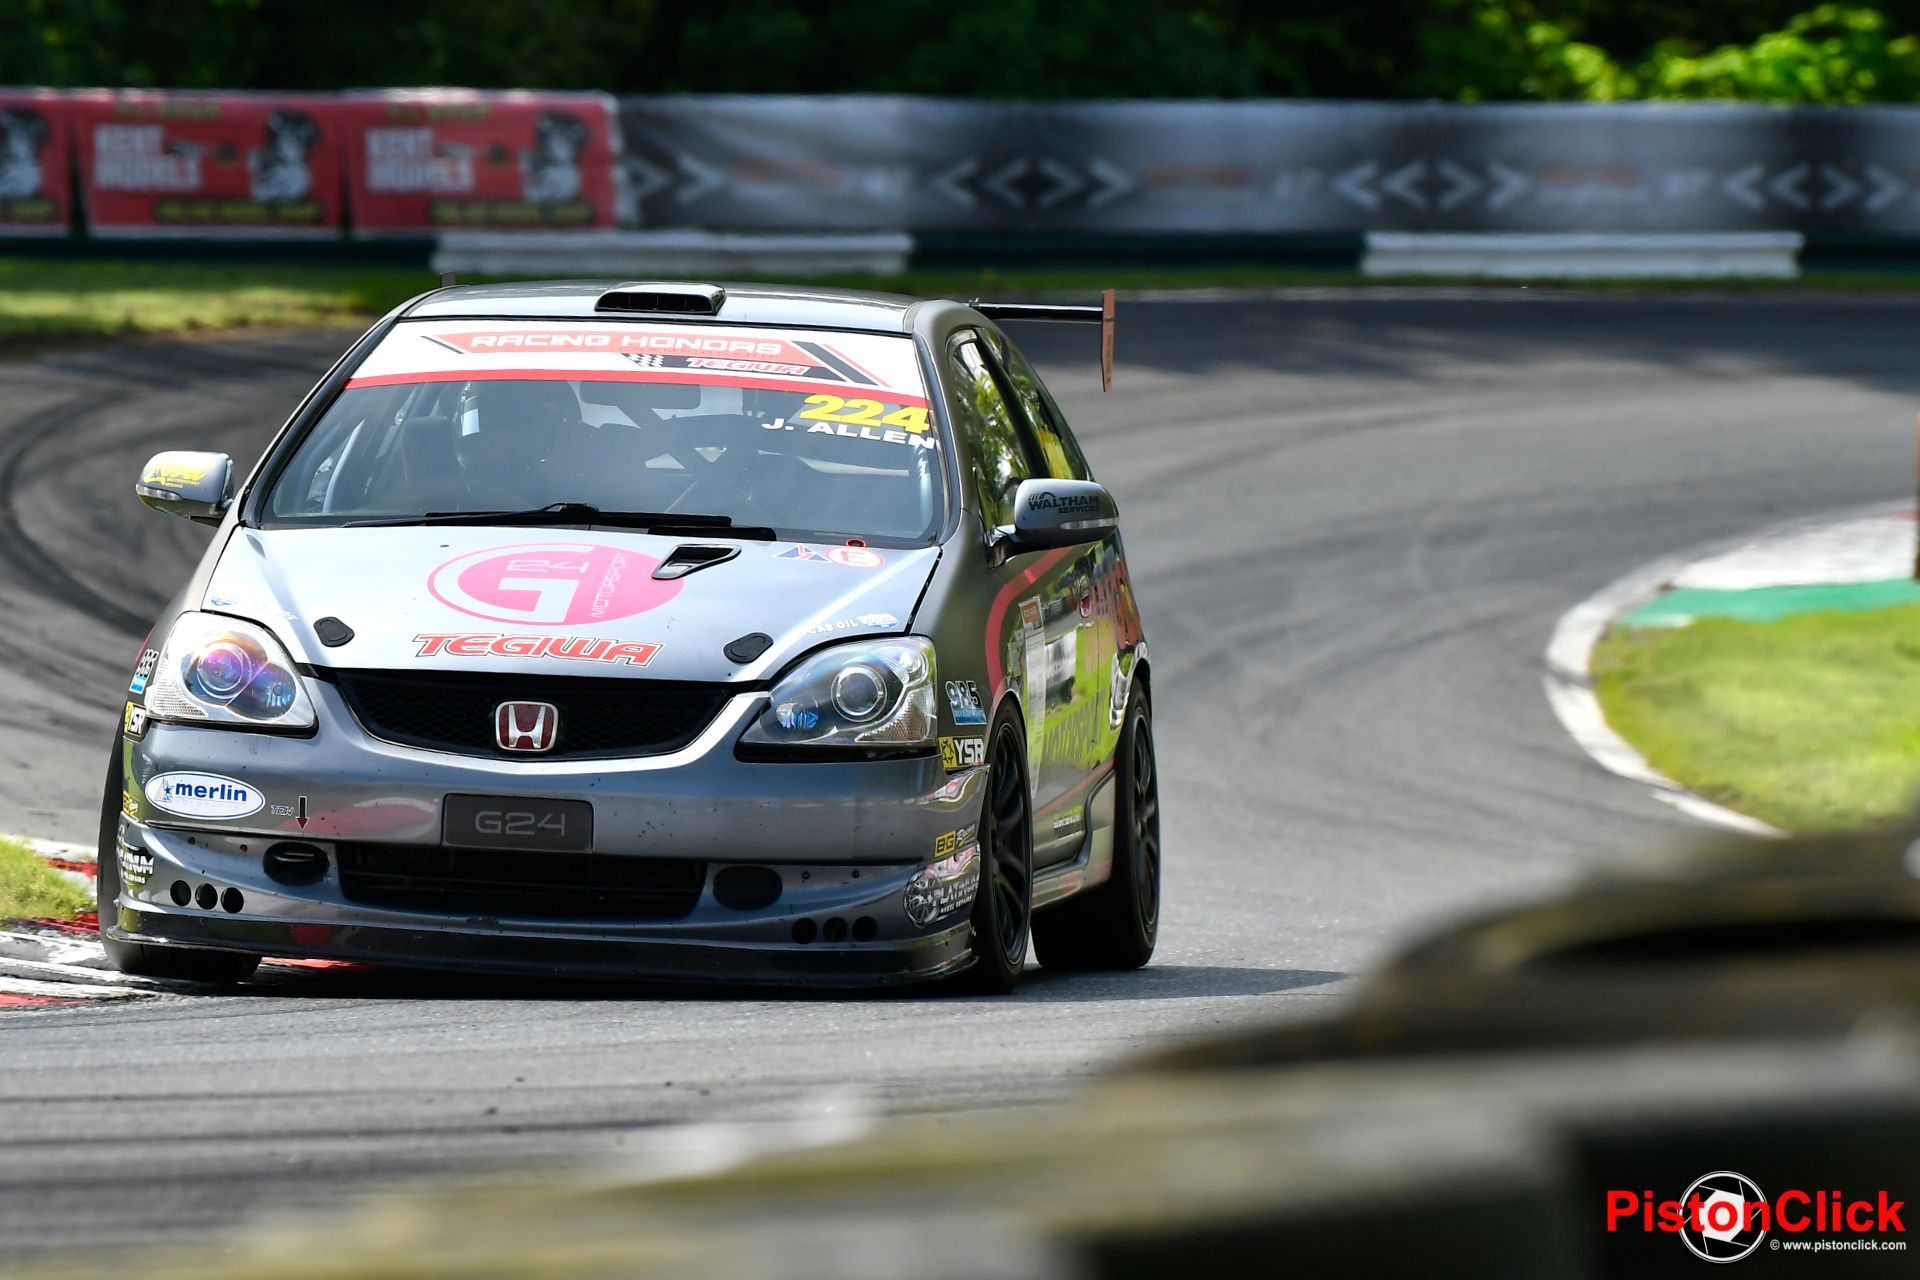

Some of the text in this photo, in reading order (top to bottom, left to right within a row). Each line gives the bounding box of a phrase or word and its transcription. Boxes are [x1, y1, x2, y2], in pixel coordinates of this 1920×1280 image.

[470, 334, 783, 355] RACING HONDAS
[685, 357, 811, 376] TEGIWA
[800, 394, 930, 434] 224
[761, 418, 936, 449] J. ALLEN
[1028, 494, 1100, 511] WALTHAM
[1058, 505, 1100, 514] SERVICES
[505, 559, 589, 574] 24
[590, 551, 632, 618] MOTORSPORT
[413, 633, 664, 667] TEGIWA
[954, 738, 984, 764] YSR
[175, 783, 247, 802] merlin
[475, 811, 566, 836] G24
[936, 833, 955, 854] BG
